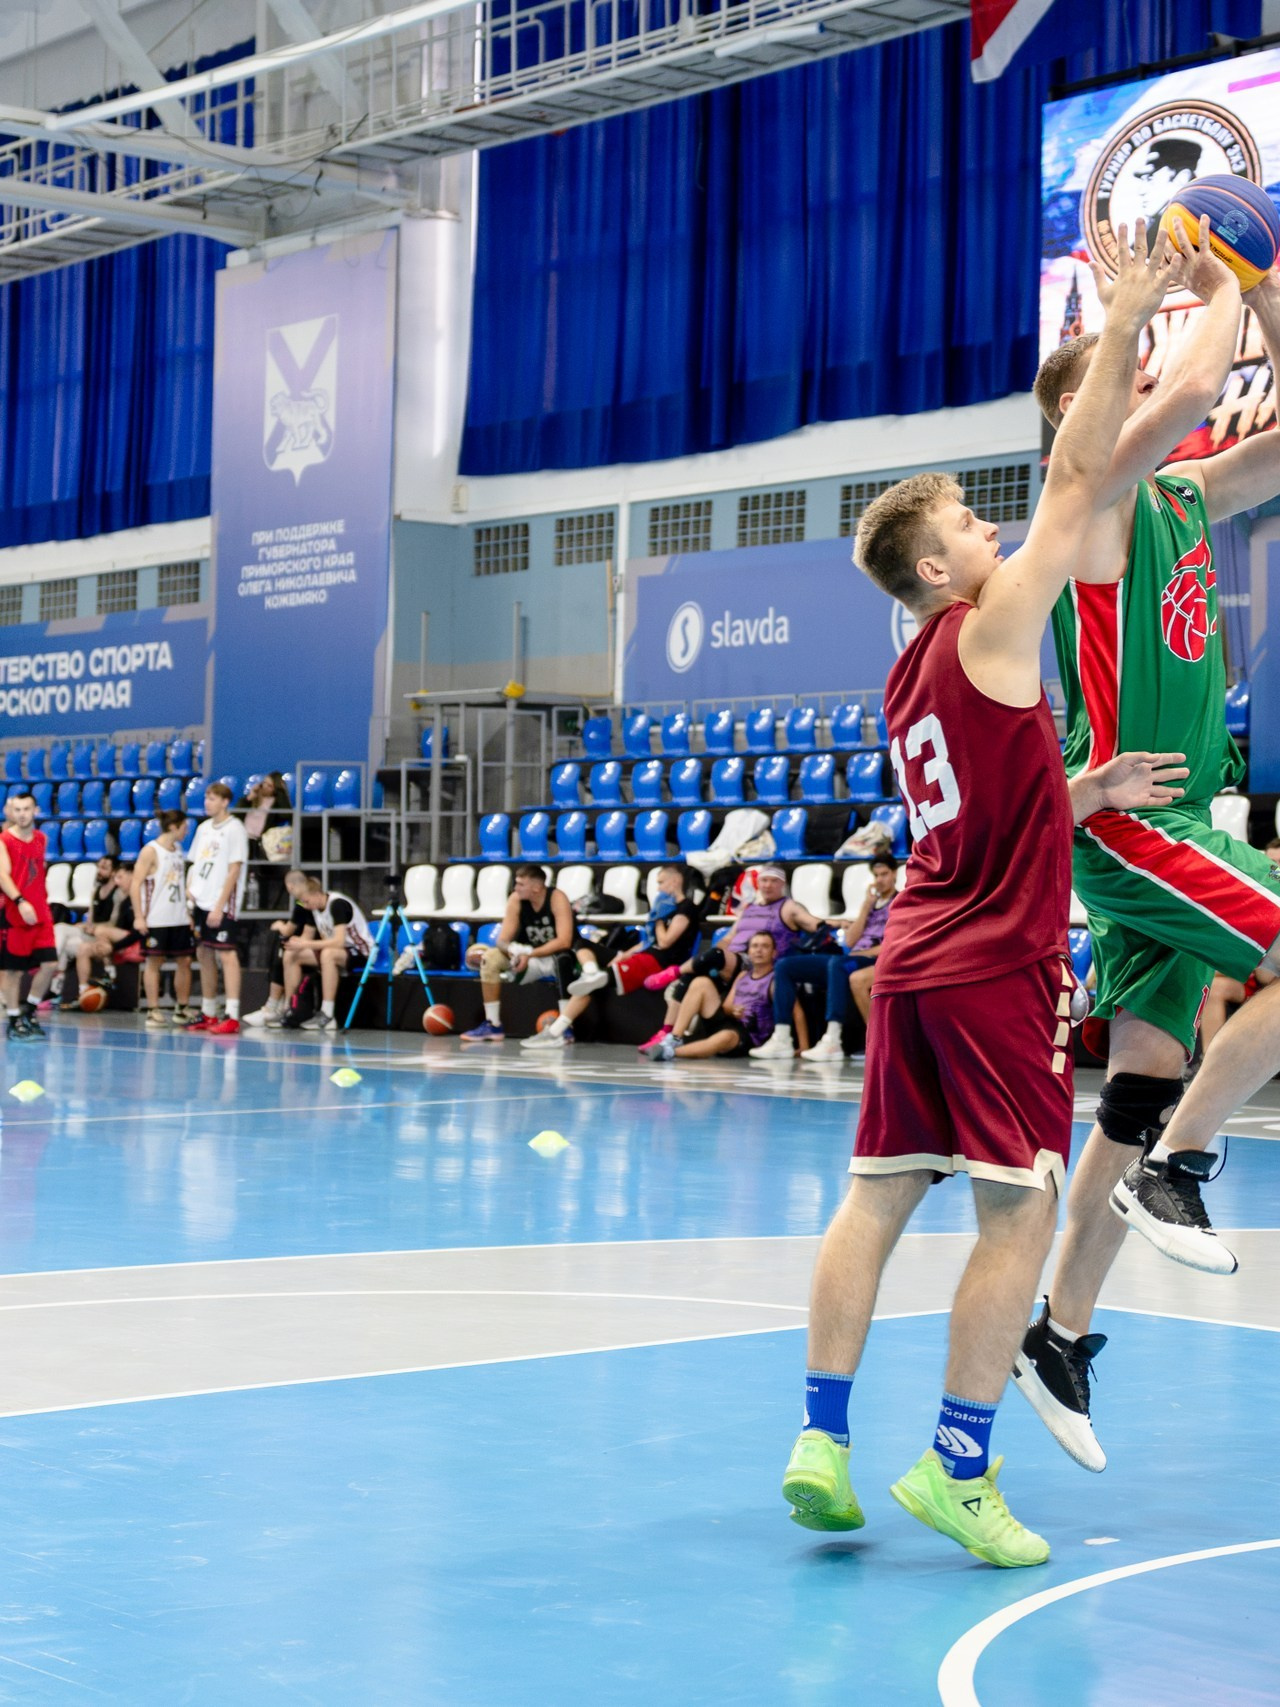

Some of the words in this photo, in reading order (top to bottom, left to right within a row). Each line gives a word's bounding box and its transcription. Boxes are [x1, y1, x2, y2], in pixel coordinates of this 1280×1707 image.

[1130, 125, 1154, 149] ПО
[1152, 113, 1236, 148] БАСКЕТБОЛУ
[251, 530, 274, 546] ПРИ
[274, 519, 345, 542] ПОДДЕРЖКЕ
[258, 537, 337, 561] ГУБЕРНАТОРА
[241, 556, 321, 580] ПРИМОРСКОГО
[323, 551, 355, 569] КРАЯ
[237, 579, 273, 597] ОЛЕГА
[274, 568, 357, 591] НИКОЛАЕВИЧА
[264, 588, 328, 610] КОЖЕМЯКО
[710, 606, 790, 648] slavda
[89, 641, 174, 677] СПОРТА
[75, 679, 132, 713] КРАЯ
[889, 712, 962, 843] 13
